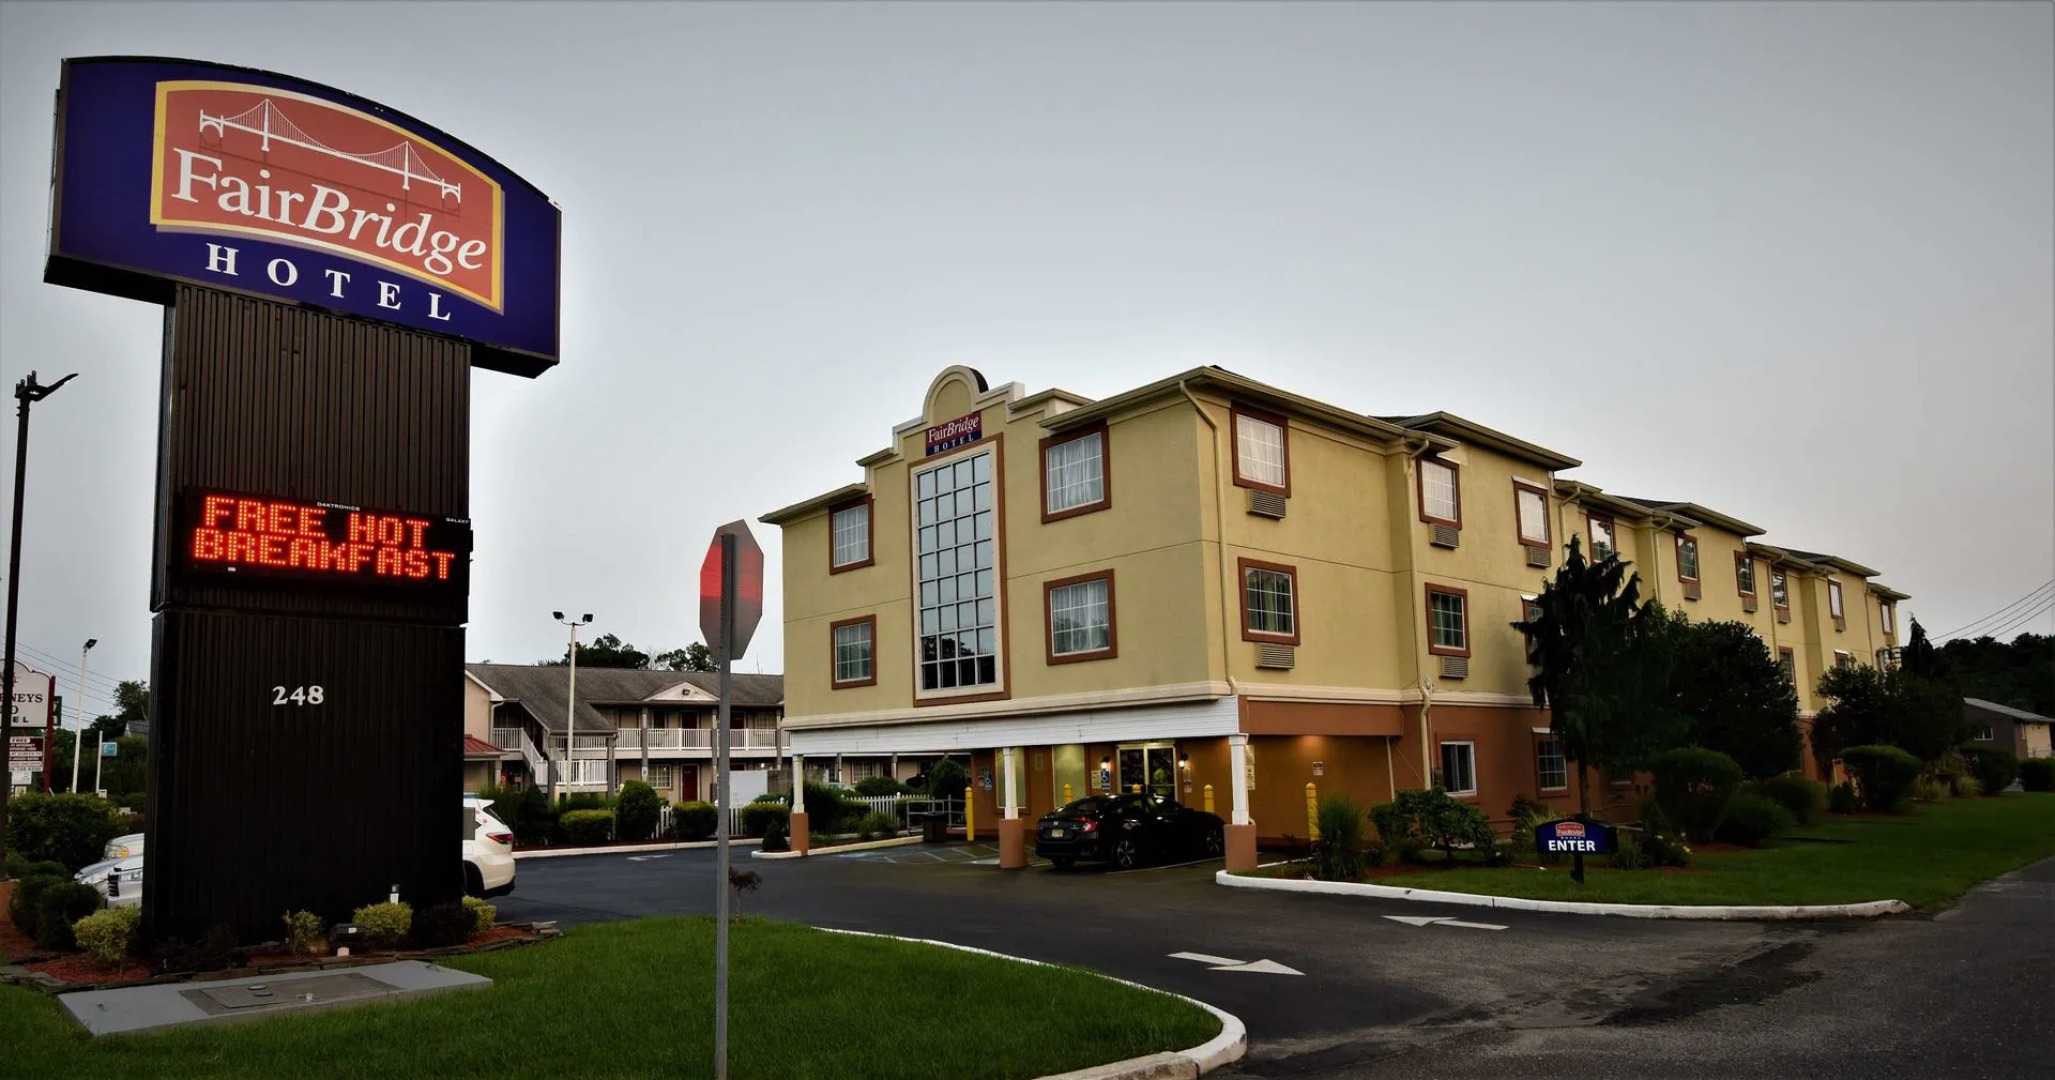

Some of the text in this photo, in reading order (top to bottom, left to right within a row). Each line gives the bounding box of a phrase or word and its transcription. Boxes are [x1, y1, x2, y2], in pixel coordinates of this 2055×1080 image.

[172, 147, 486, 275] FairBridge
[206, 243, 450, 321] HOTEL
[928, 416, 979, 443] FairBridge
[934, 434, 974, 453] HOTEL
[317, 502, 360, 511] DAKTRONICS
[205, 496, 430, 548] FREE HOT
[195, 528, 455, 579] BREAKFAST
[272, 685, 324, 706] 248
[1548, 840, 1596, 851] ENTER
